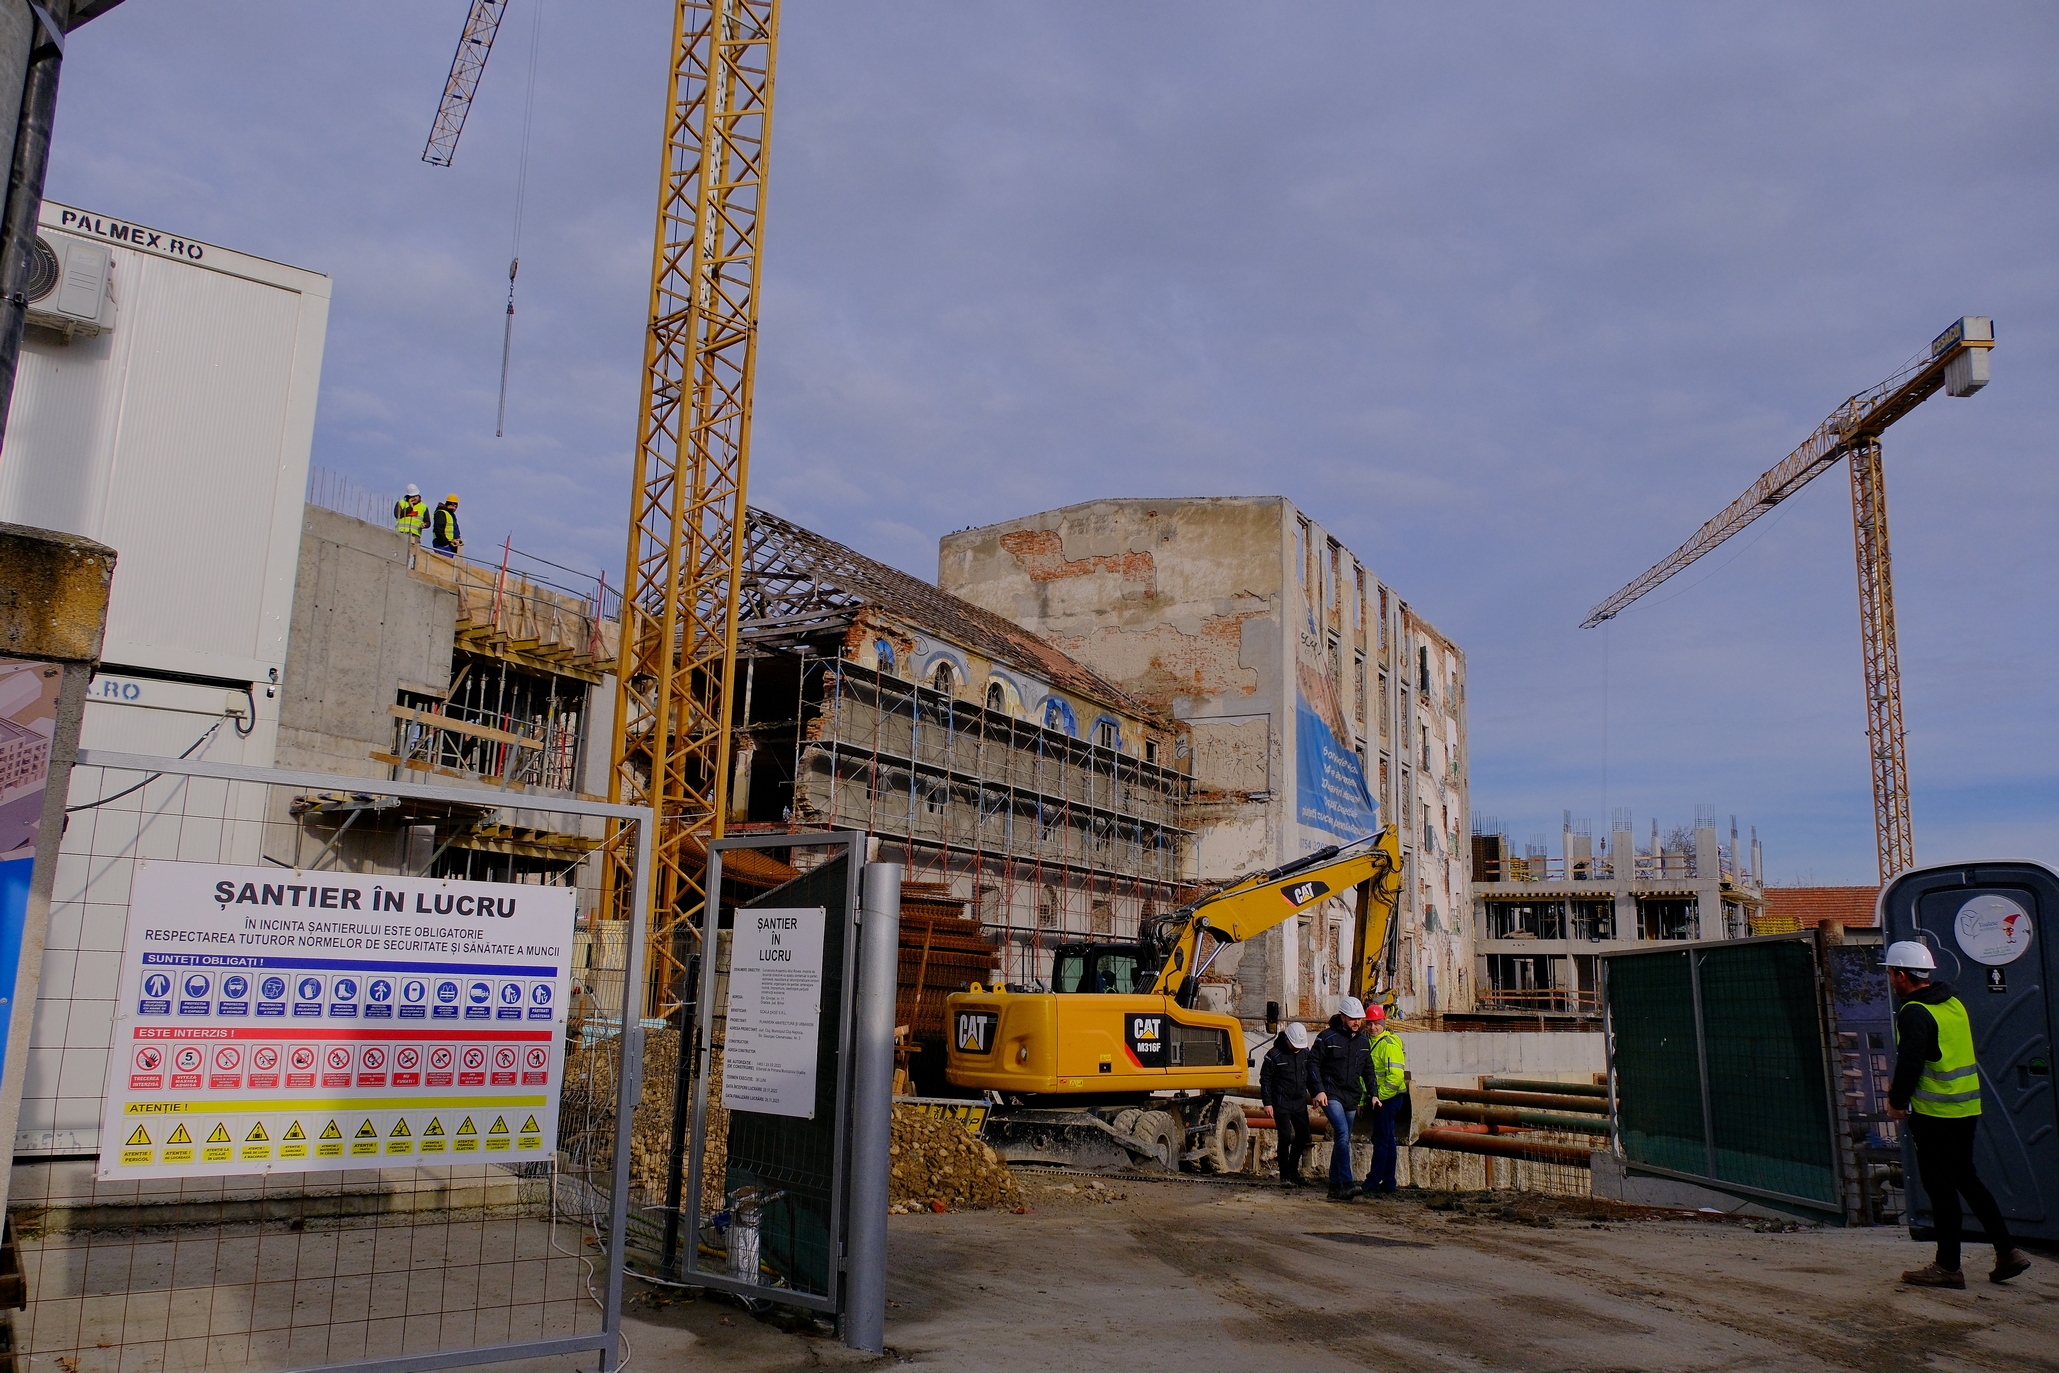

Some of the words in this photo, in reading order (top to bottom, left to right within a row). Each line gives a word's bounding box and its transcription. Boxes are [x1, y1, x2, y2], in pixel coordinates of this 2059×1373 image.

[61, 209, 204, 260] PALMEX.RO
[214, 880, 361, 911] ȘANTIER
[372, 885, 405, 913] ÎN
[415, 892, 516, 919] LUCRU
[1294, 882, 1315, 904] CAT
[244, 915, 257, 930] ÎN
[259, 918, 305, 932] INCINTA
[308, 921, 381, 936] ȘANTIERULUI
[384, 924, 411, 938] ESTE
[414, 926, 484, 940] OBLIGATORIE
[757, 917, 798, 933] ȘANTIER
[145, 929, 236, 944] RESPECTAREA
[239, 933, 295, 946] TUTUROR
[298, 936, 362, 949] NORMELOR
[365, 938, 380, 950] DE
[383, 939, 448, 953] SECURITATE
[450, 942, 460, 956] ȘI
[463, 941, 515, 955] SĂNĂTATE
[517, 945, 524, 955] A
[526, 945, 560, 957] MUNCII
[771, 930, 781, 945] ÎN
[147, 954, 199, 966] SUNTEȚI
[202, 955, 257, 968] OBLIGAȚI
[759, 949, 792, 962] LUCRU
[138, 1029, 171, 1038] ESTE
[173, 1029, 228, 1038] INTERZIS
[958, 1014, 987, 1050] CAT
[1133, 1018, 1161, 1039] CAT
[1136, 1042, 1161, 1053] M316F
[185, 1052, 193, 1061] 5
[129, 1103, 181, 1114] ATENȚIE
[184, 1103, 188, 1112] !
